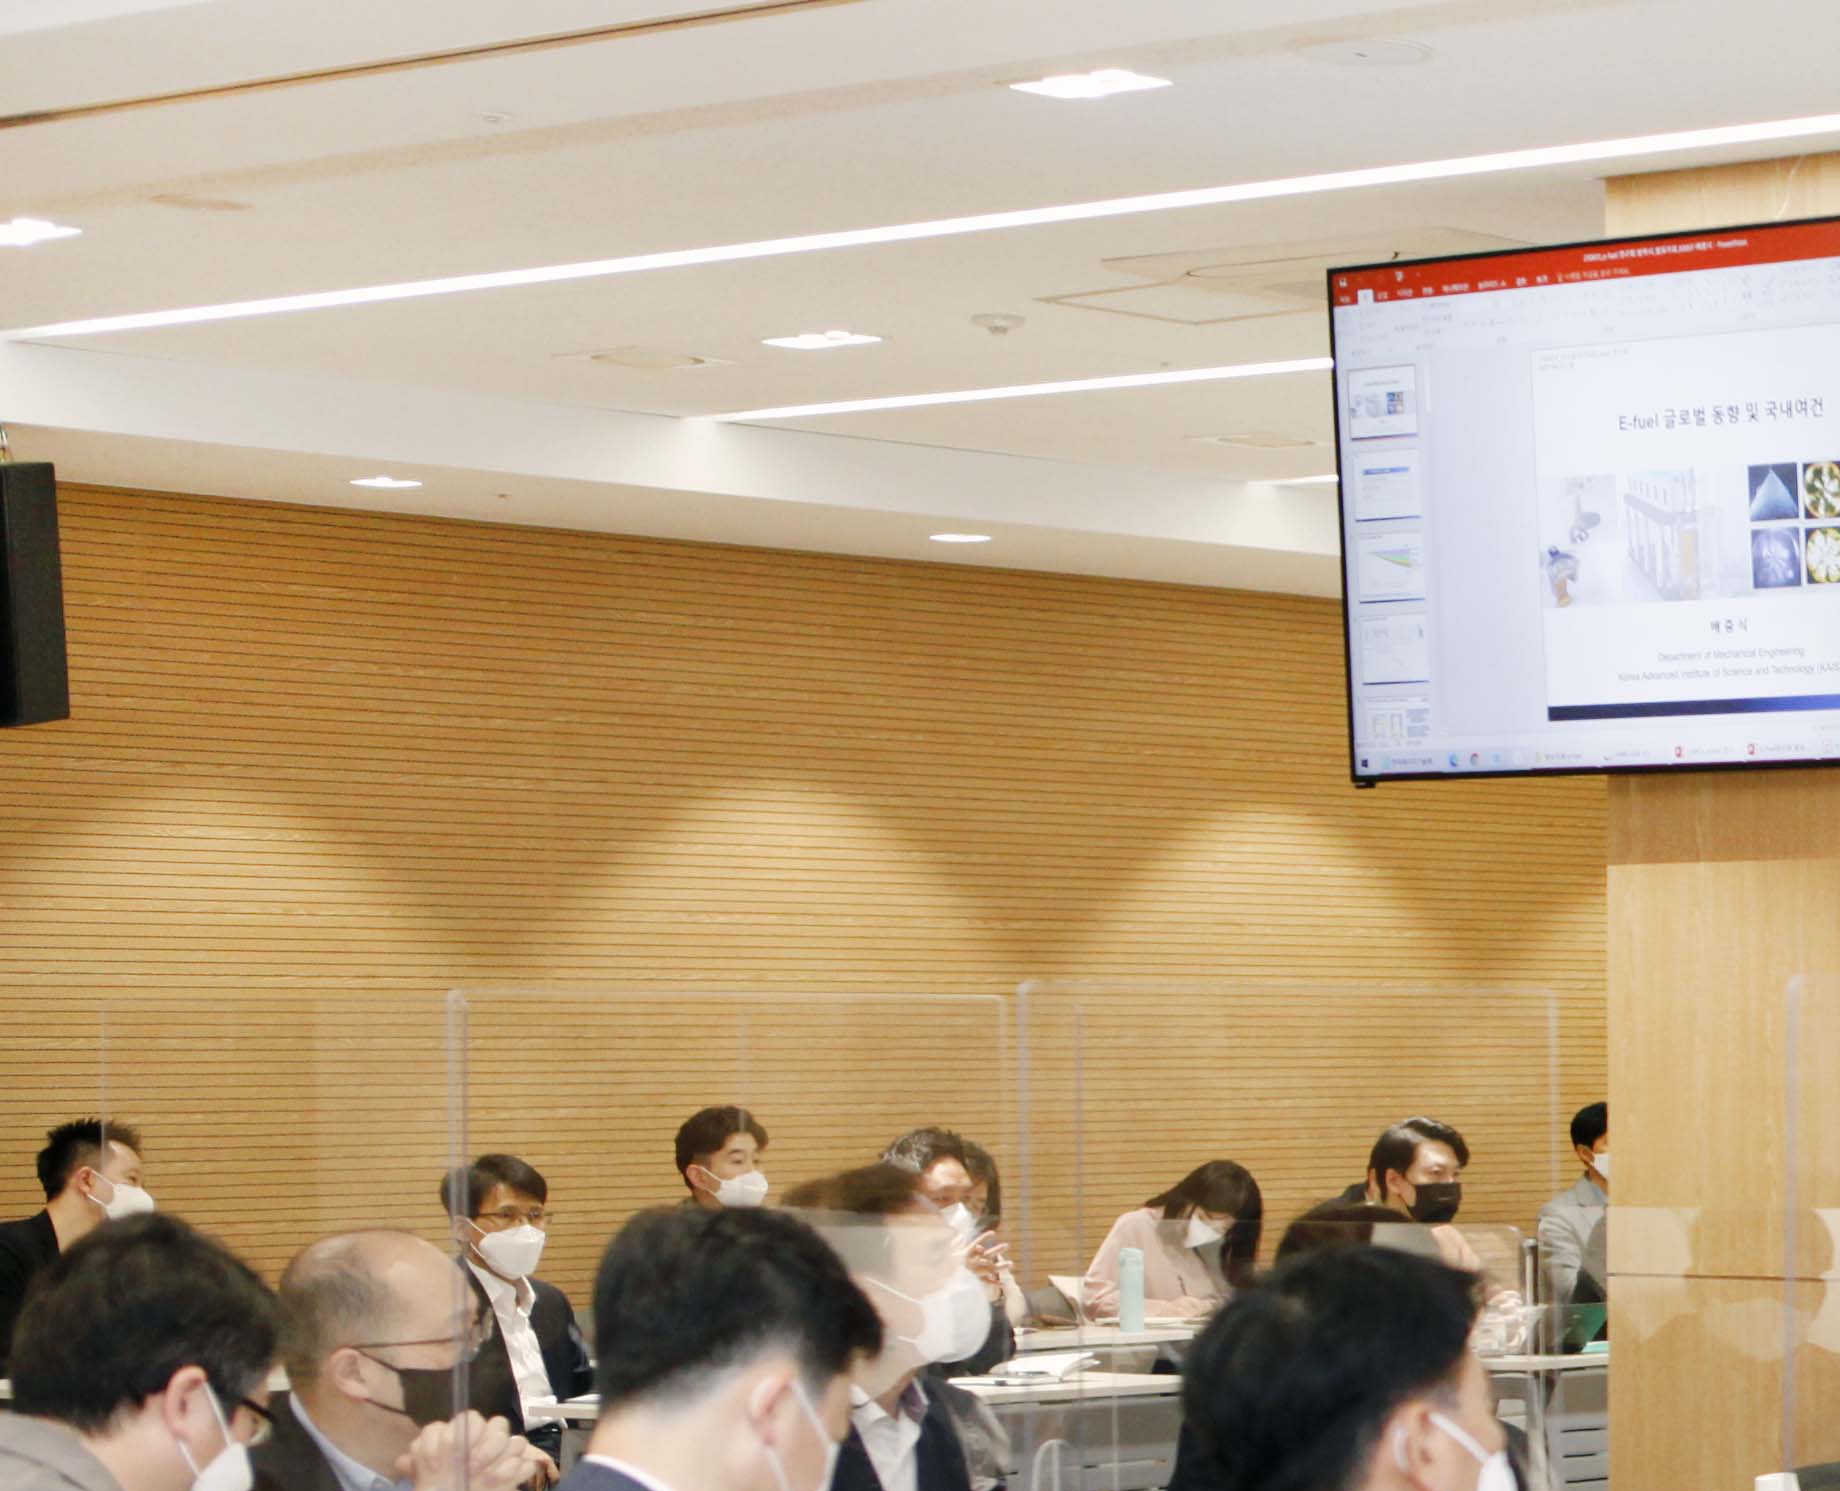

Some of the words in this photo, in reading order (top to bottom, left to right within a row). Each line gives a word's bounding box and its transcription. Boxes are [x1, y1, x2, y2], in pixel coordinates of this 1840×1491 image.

[1618, 413, 1660, 431] E-fuel
[1664, 408, 1706, 429] 글로벌
[1712, 405, 1740, 425] 동향
[1746, 401, 1759, 422] 및
[1763, 397, 1824, 420] 국내여건
